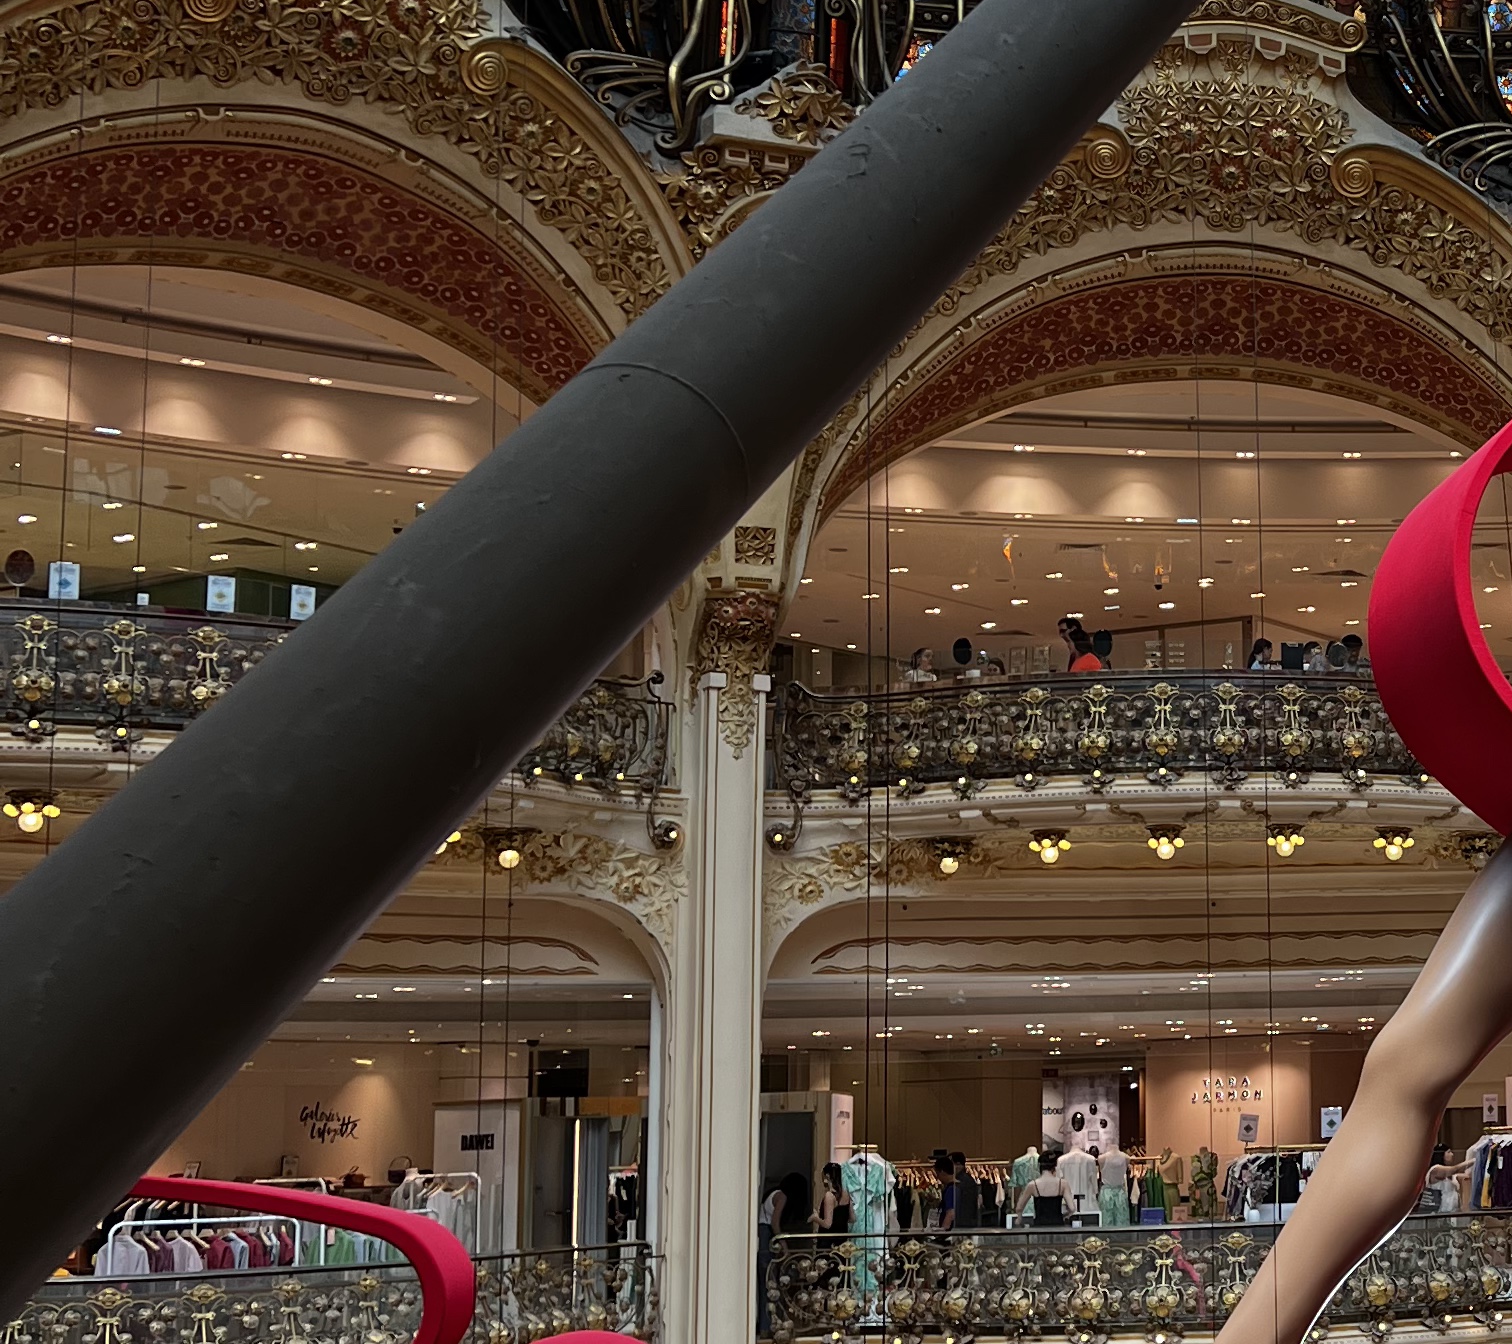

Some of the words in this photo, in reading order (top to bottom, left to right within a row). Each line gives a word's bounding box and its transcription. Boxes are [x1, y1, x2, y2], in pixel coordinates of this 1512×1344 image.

[1203, 1076, 1250, 1088] TARA
[1192, 1089, 1263, 1103] JARMON
[460, 1133, 494, 1151] DAWEI
